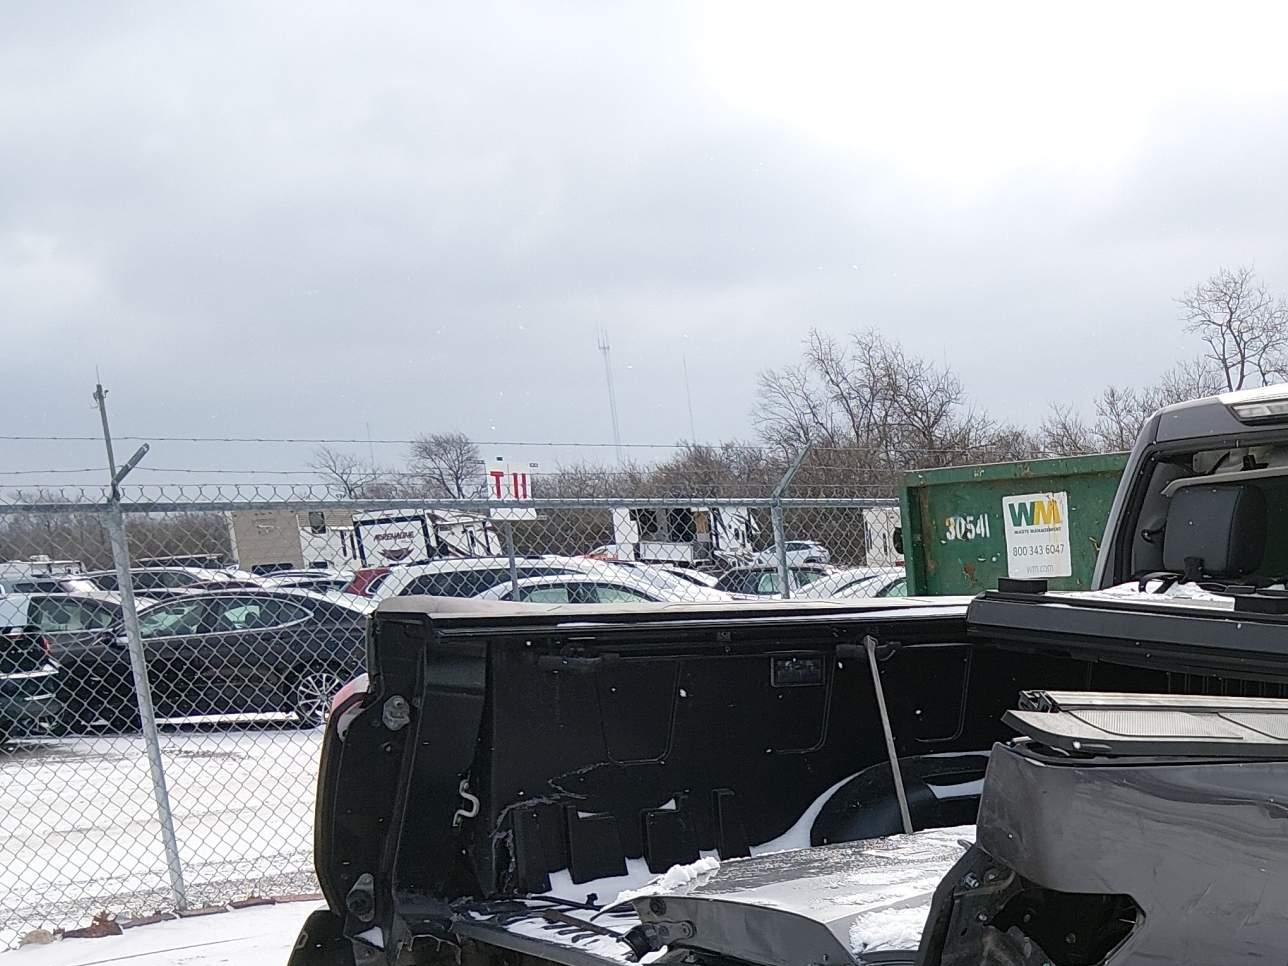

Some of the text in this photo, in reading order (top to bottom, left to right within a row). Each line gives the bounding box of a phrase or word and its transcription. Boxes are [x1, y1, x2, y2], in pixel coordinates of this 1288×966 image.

[945, 513, 990, 540] 30541
[1008, 500, 1062, 527] WM
[1013, 543, 1065, 557] 800 343 6047
